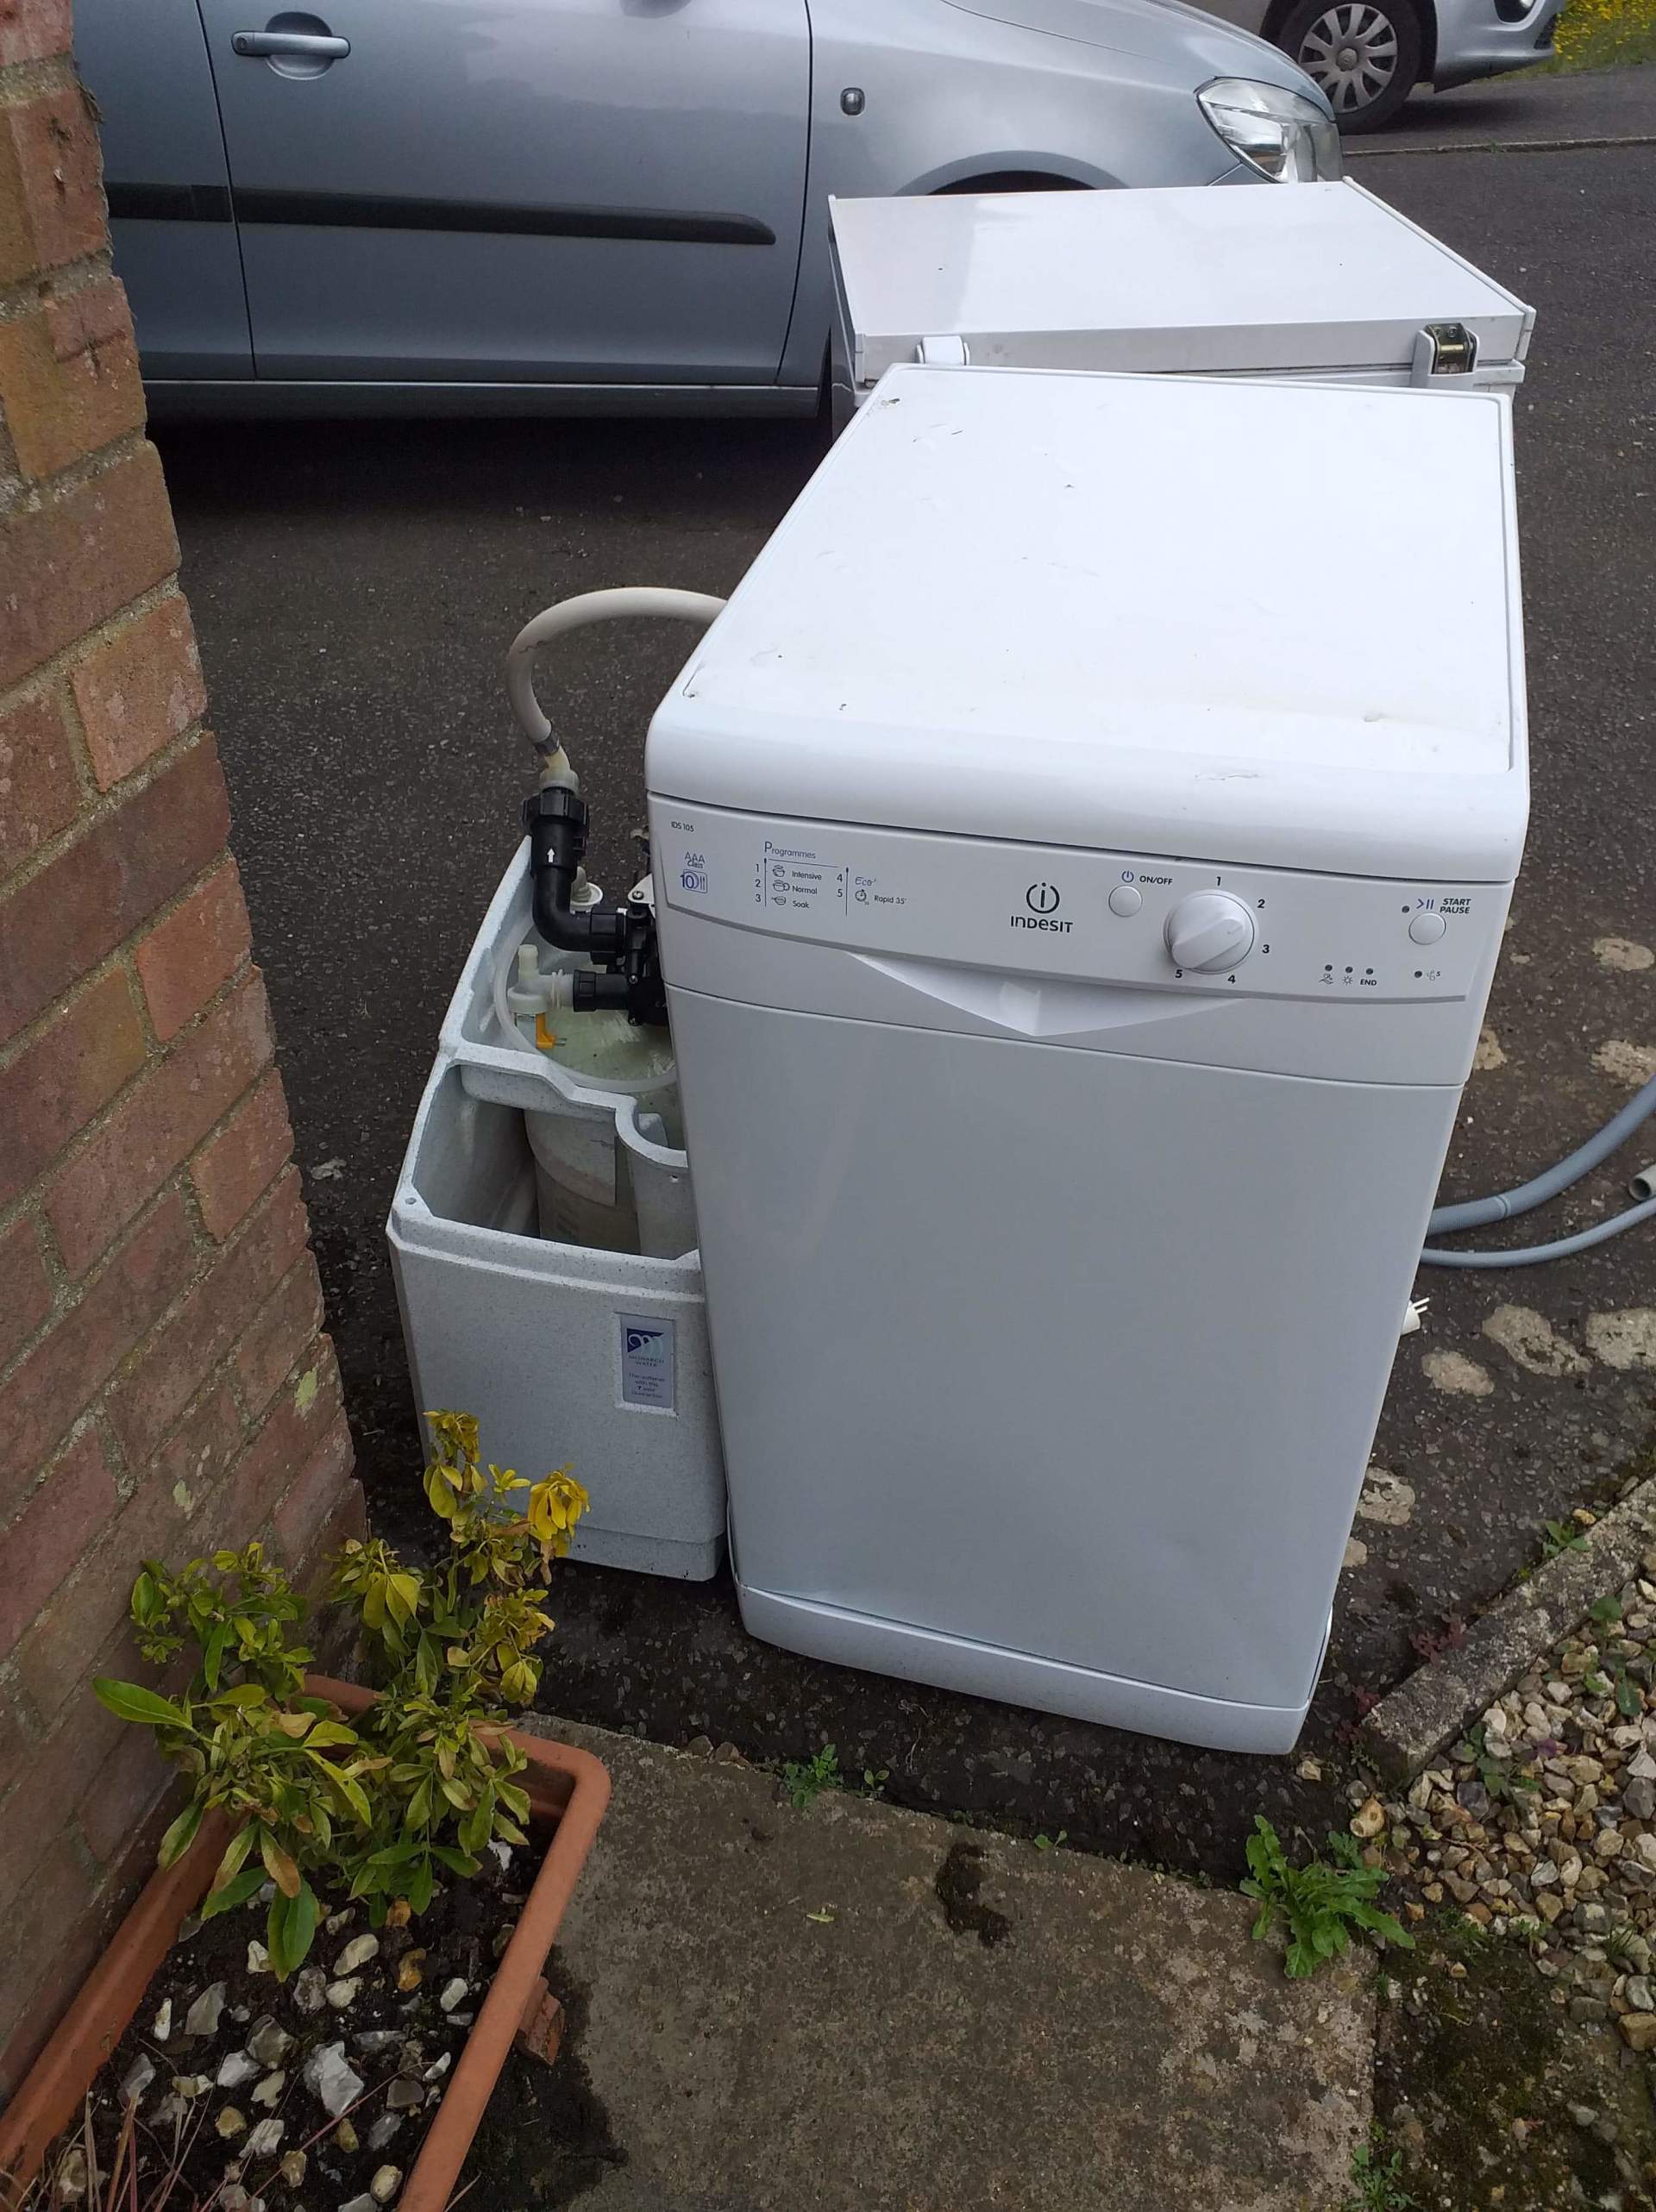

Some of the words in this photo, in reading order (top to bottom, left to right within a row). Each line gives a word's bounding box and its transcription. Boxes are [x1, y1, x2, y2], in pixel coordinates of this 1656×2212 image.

[683, 823, 694, 832] 105
[764, 841, 816, 859] Programmes
[685, 851, 706, 863] AAA
[755, 863, 760, 873] 1
[792, 870, 822, 880] Intensive
[837, 873, 843, 882] 4
[1138, 875, 1173, 886] ON/OFF
[1215, 876, 1221, 887] 1
[755, 879, 762, 888] 2
[792, 885, 818, 894] Normal
[755, 893, 762, 903] 3
[793, 899, 810, 908] Soak
[837, 888, 843, 898] 5
[874, 894, 894, 905] Rapid
[1257, 899, 1265, 909] 2
[1442, 898, 1471, 906] START
[1440, 905, 1471, 914] PAUSE
[1262, 944, 1270, 954] 3
[1175, 969, 1183, 979] 5
[1227, 974, 1236, 984] 4
[1360, 978, 1377, 987] END
